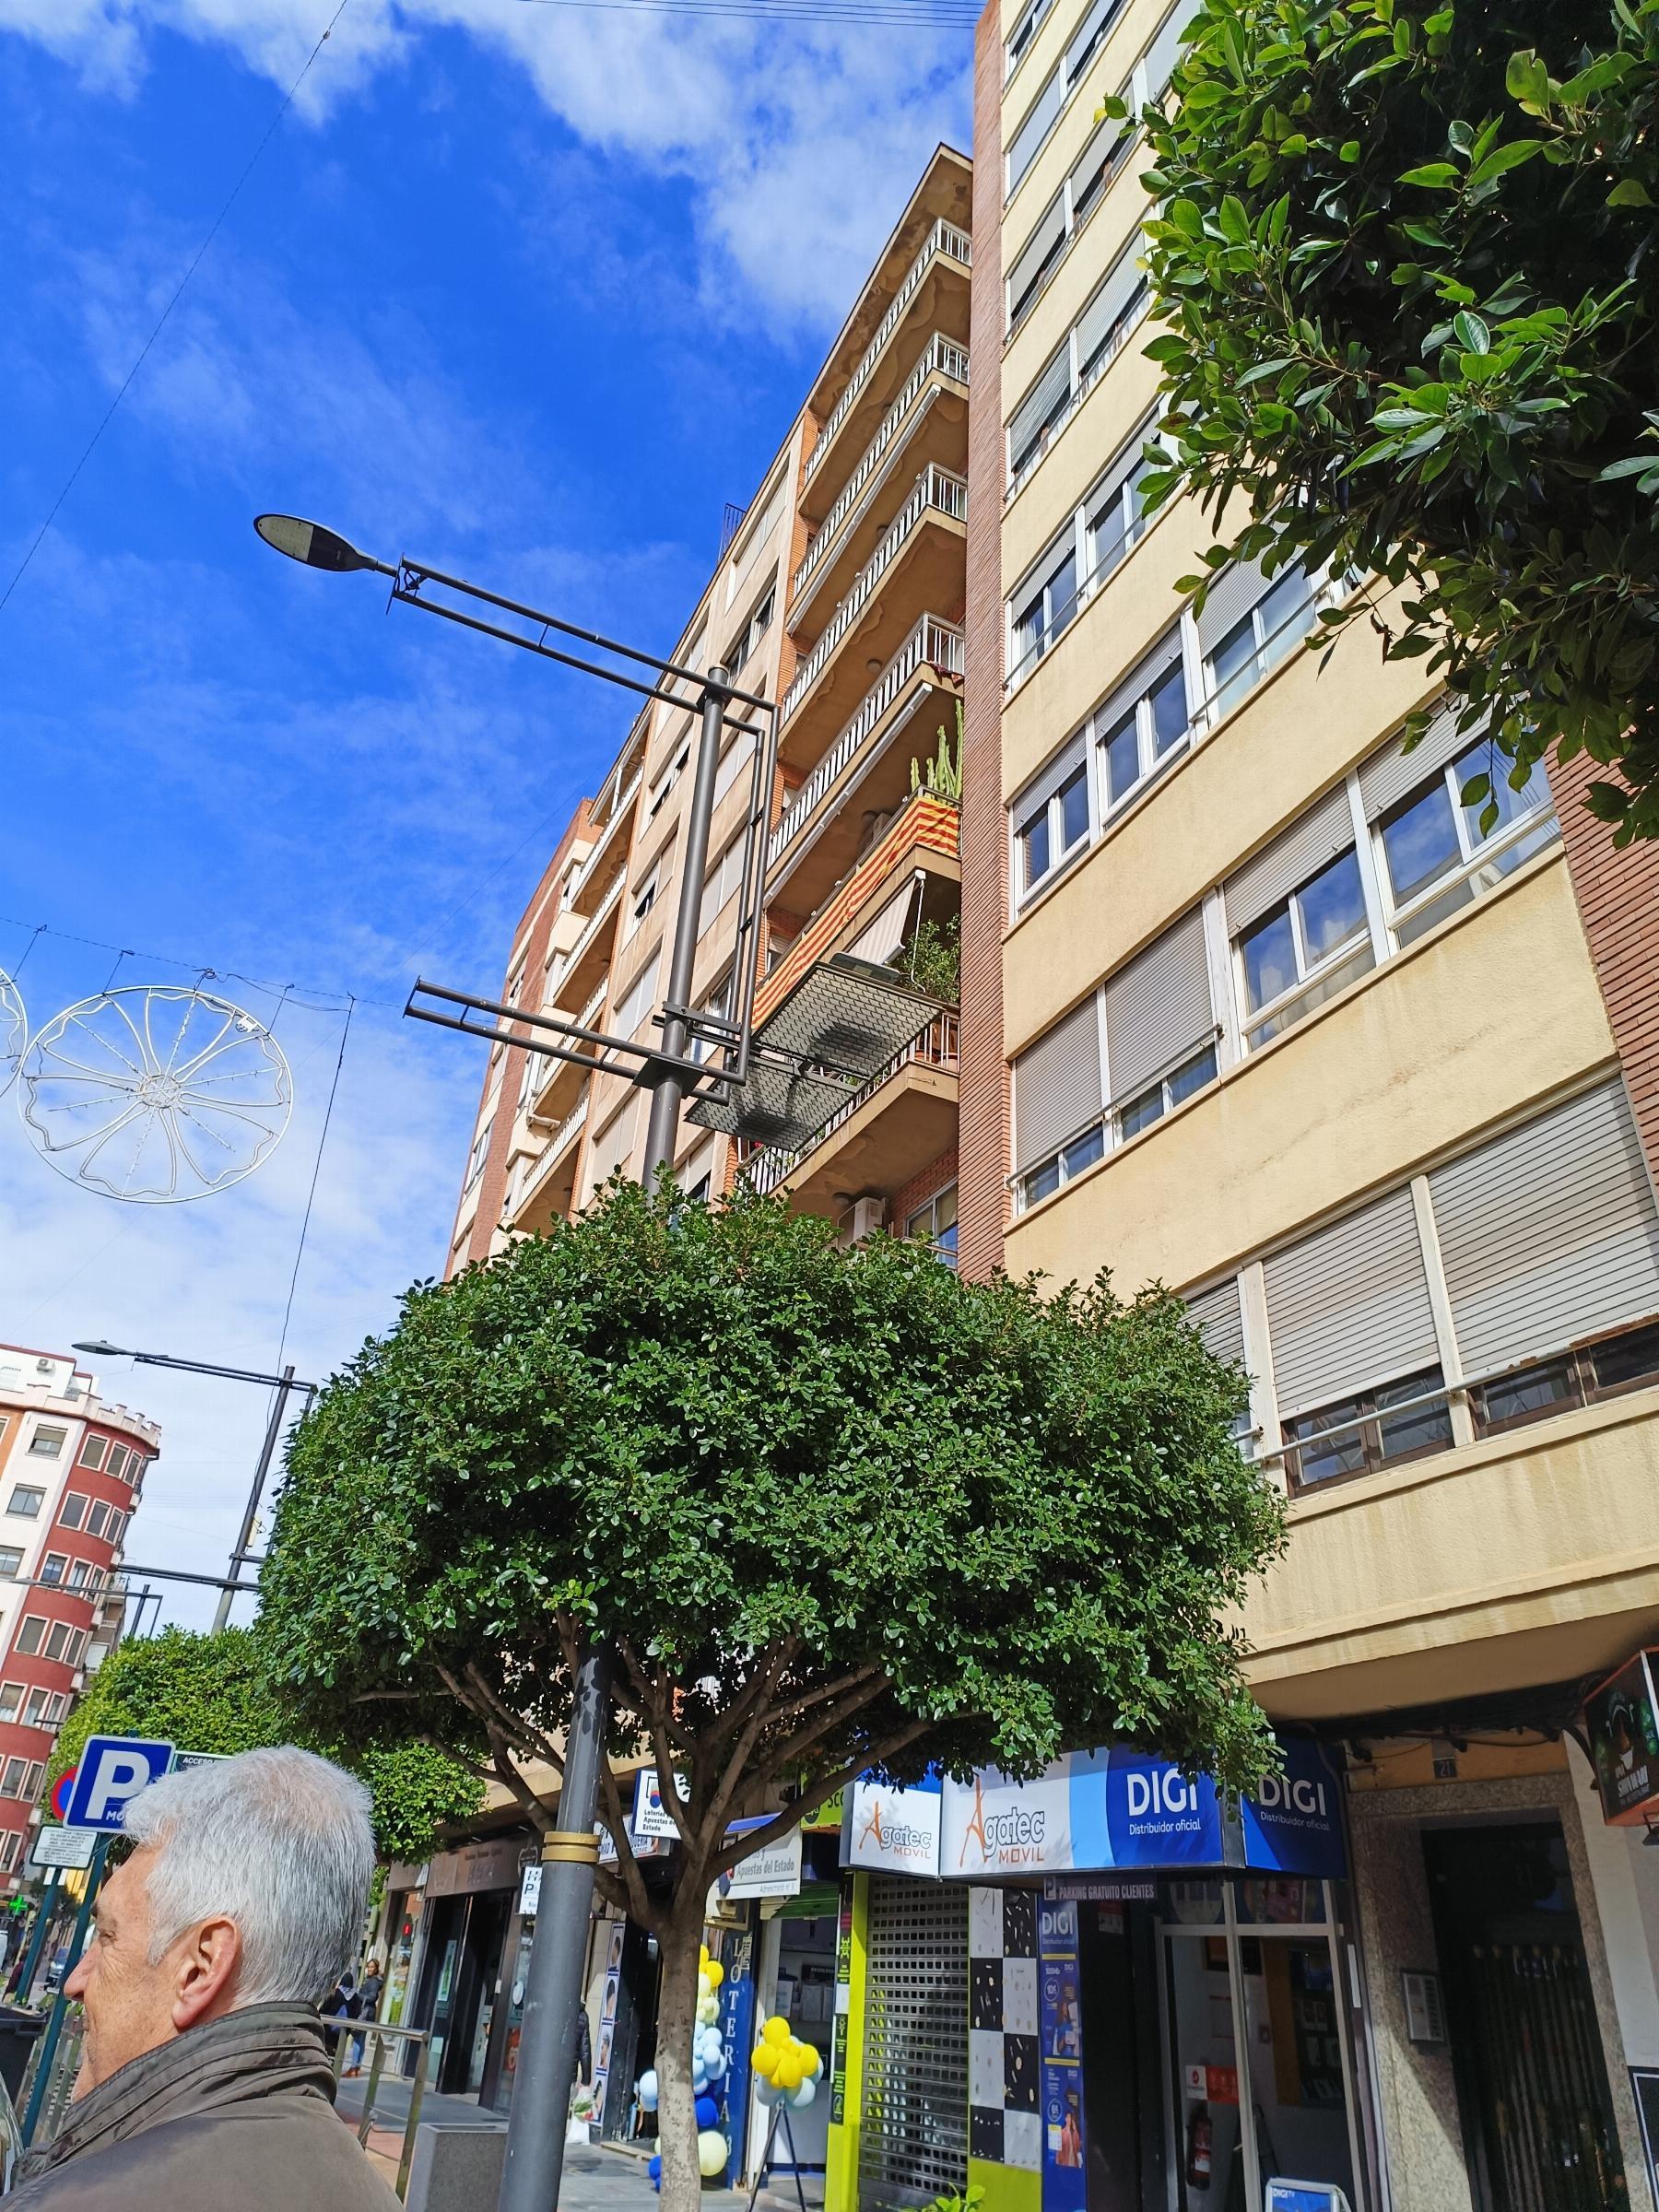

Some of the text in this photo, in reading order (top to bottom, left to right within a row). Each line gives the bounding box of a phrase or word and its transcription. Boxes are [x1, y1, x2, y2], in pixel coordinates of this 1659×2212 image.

[85, 1749, 150, 1819] P
[1126, 1769, 1197, 1817] DIGI
[1258, 1773, 1326, 1816] DIGI
[106, 1810, 124, 1822] MO
[959, 1776, 1045, 1868] Agatec
[1260, 1811, 1331, 1831] Distribuidor oficial
[859, 1800, 932, 1851] Agatec
[1129, 1818, 1201, 1835] Distribuidor oficial
[893, 1846, 931, 1859] MOVIL
[999, 1847, 1045, 1864] MOVIL
[763, 1860, 773, 1875] del
[774, 1858, 794, 1873] Estado
[1059, 1886, 1087, 1900] PARKING
[1088, 1885, 1120, 1900] GRATUITO
[1121, 1884, 1154, 1899] CLIENTES
[1041, 1911, 1073, 1935] DIGI
[1273, 2188, 1288, 2198] DIGI
